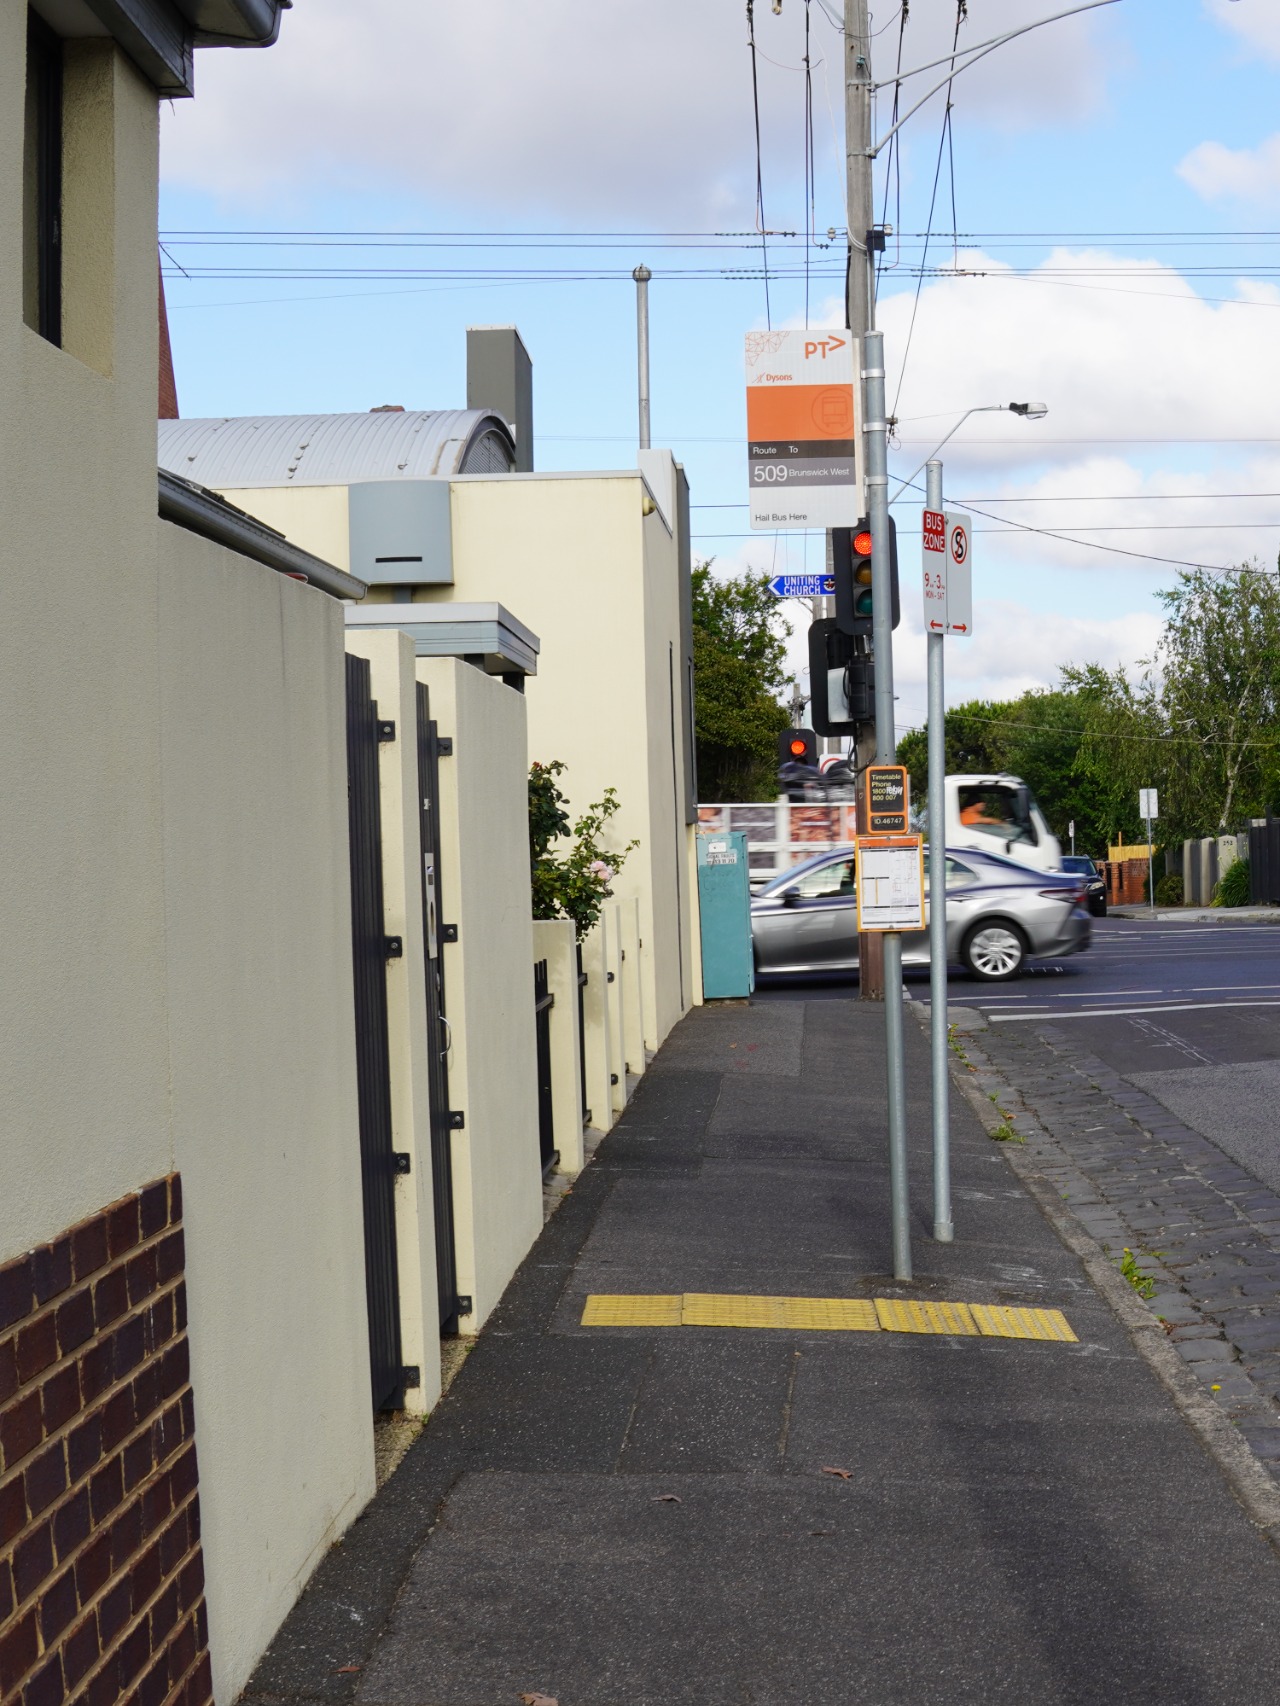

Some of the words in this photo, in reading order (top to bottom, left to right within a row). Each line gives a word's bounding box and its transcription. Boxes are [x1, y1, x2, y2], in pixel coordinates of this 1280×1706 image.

[766, 374, 793, 383] Dysons
[753, 446, 777, 455] Route
[788, 446, 798, 454] To
[754, 465, 787, 482] 509
[789, 469, 828, 477] Brunswick
[830, 467, 850, 476] West
[755, 514, 770, 522] Hail
[772, 513, 787, 521] Bus
[789, 513, 807, 521] Here
[926, 514, 942, 531] BUS
[924, 533, 945, 551] ZONE
[784, 576, 821, 586] UNITING
[784, 585, 821, 595] CHURCH
